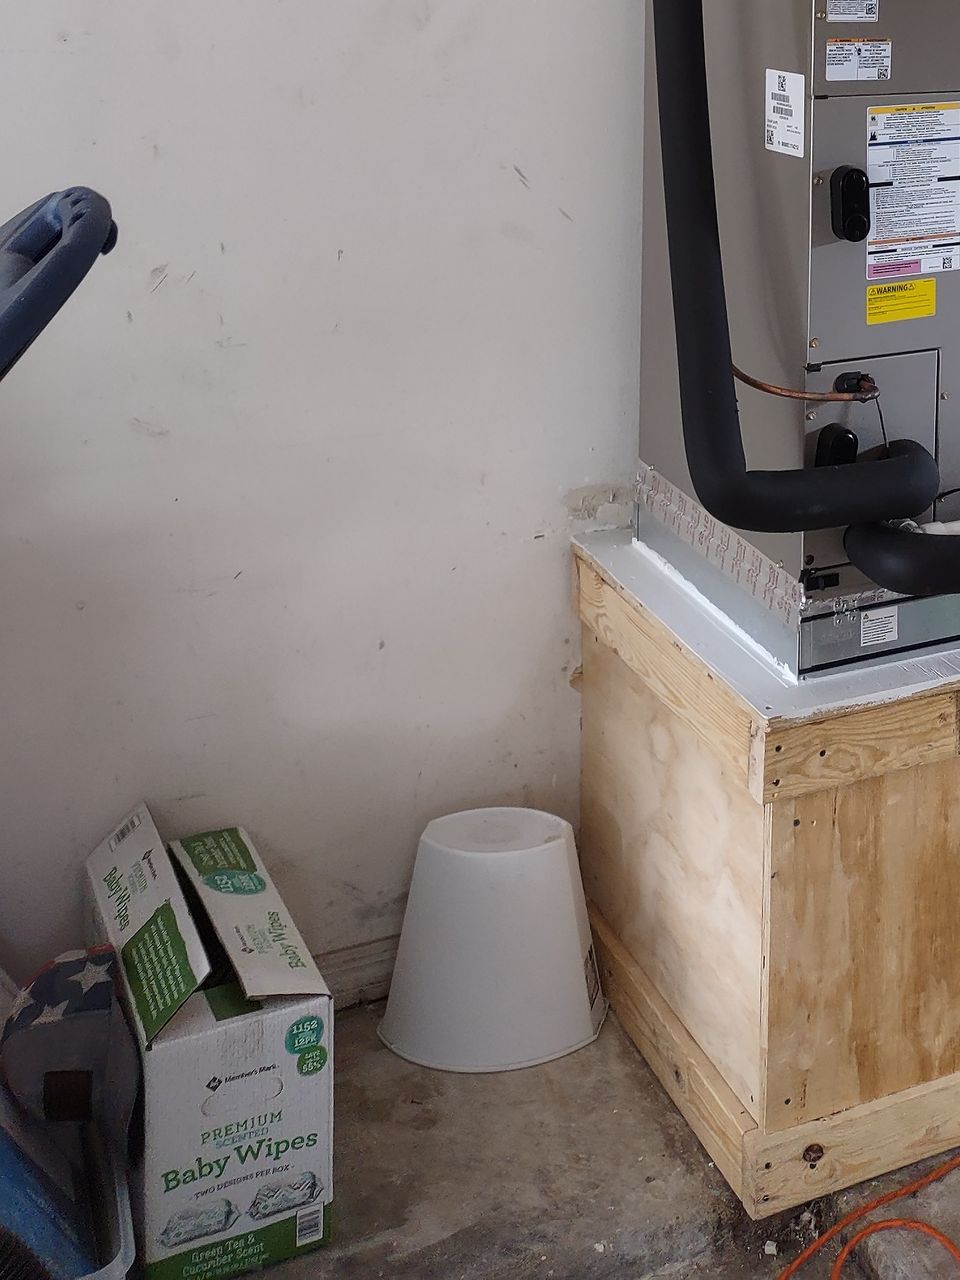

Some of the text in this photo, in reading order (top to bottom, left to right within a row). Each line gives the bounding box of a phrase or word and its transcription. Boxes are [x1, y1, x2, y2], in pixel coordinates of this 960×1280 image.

[876, 284, 909, 295] WARNING
[103, 866, 132, 932] Baby Wipes
[292, 1020, 318, 1034] 1152
[201, 1110, 283, 1145] PREMIUM
[215, 1128, 269, 1149] SCENTED
[161, 1132, 318, 1195] Baby Wipes
[193, 1187, 216, 1200] TWO
[181, 1253, 233, 1278] Cucumber
[236, 1242, 266, 1258] Scent
[191, 1245, 223, 1264] Green
[225, 1237, 246, 1251] Tea
